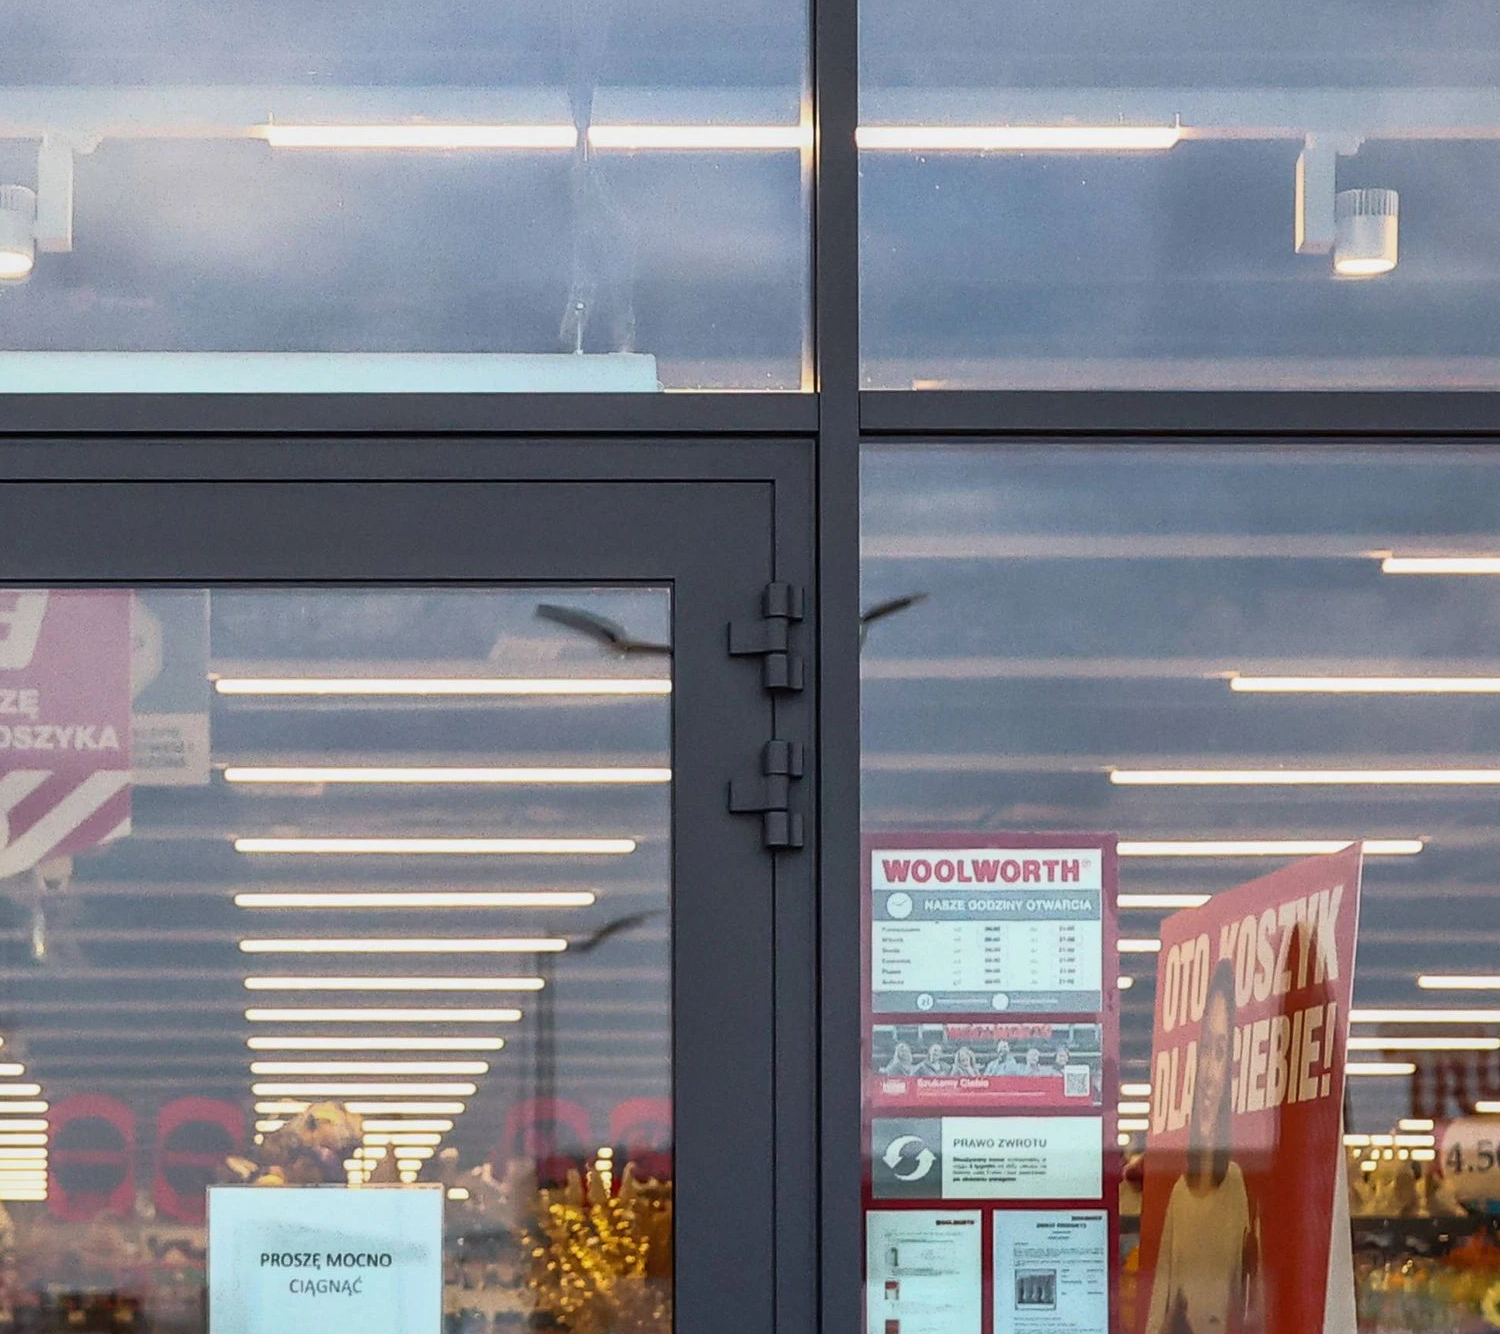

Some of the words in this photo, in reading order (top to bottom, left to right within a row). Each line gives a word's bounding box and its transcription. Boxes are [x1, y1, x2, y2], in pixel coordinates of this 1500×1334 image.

[881, 859, 1081, 884] WOOLWORTH
[924, 898, 966, 911] NASZE
[1163, 932, 1211, 1033] OTO
[1153, 1040, 1198, 1136] DLA
[953, 1138, 996, 1148] PRAWO
[998, 1138, 1048, 1148] ZWROTU
[260, 1252, 321, 1270] PROSZĘ
[326, 1252, 392, 1267] MOCNO
[289, 1276, 363, 1296] CIĄGNĄĆ
